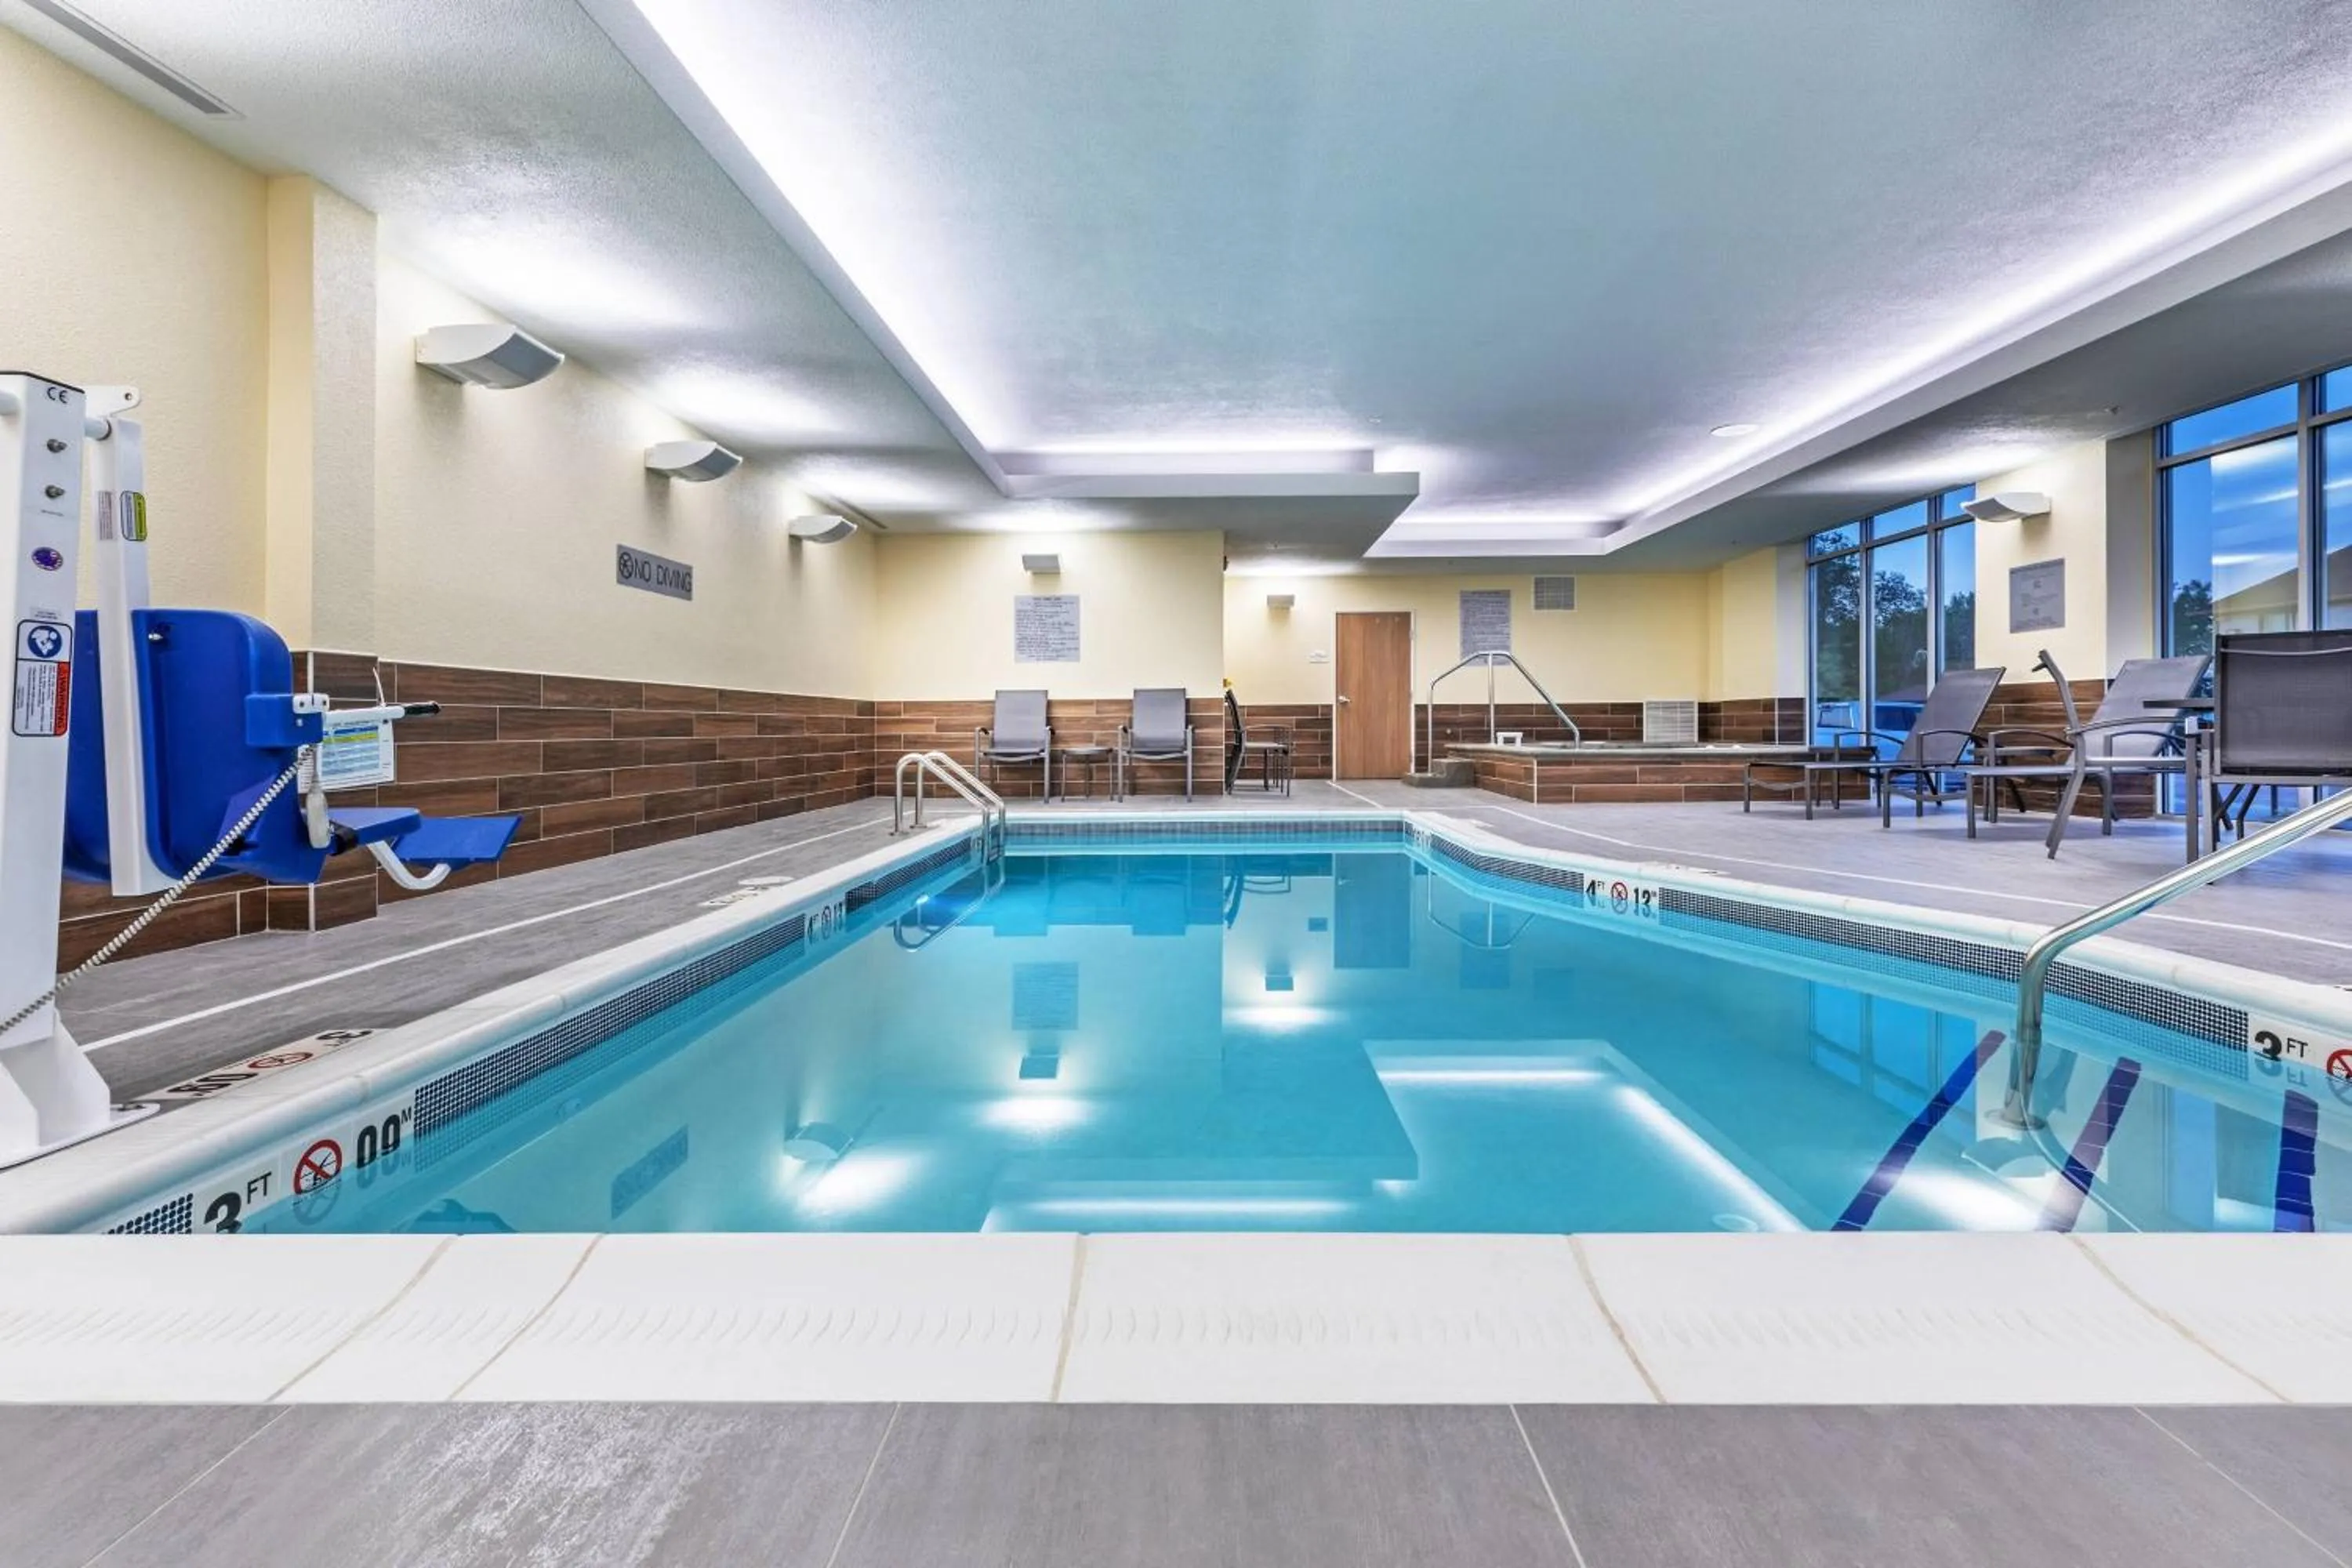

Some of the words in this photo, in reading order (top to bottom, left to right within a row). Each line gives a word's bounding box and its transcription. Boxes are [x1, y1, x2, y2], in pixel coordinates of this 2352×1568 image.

[634, 557, 652, 583] NO
[657, 564, 692, 593] DIVING
[2287, 1037, 2309, 1058] FT
[247, 1171, 272, 1205] FT
